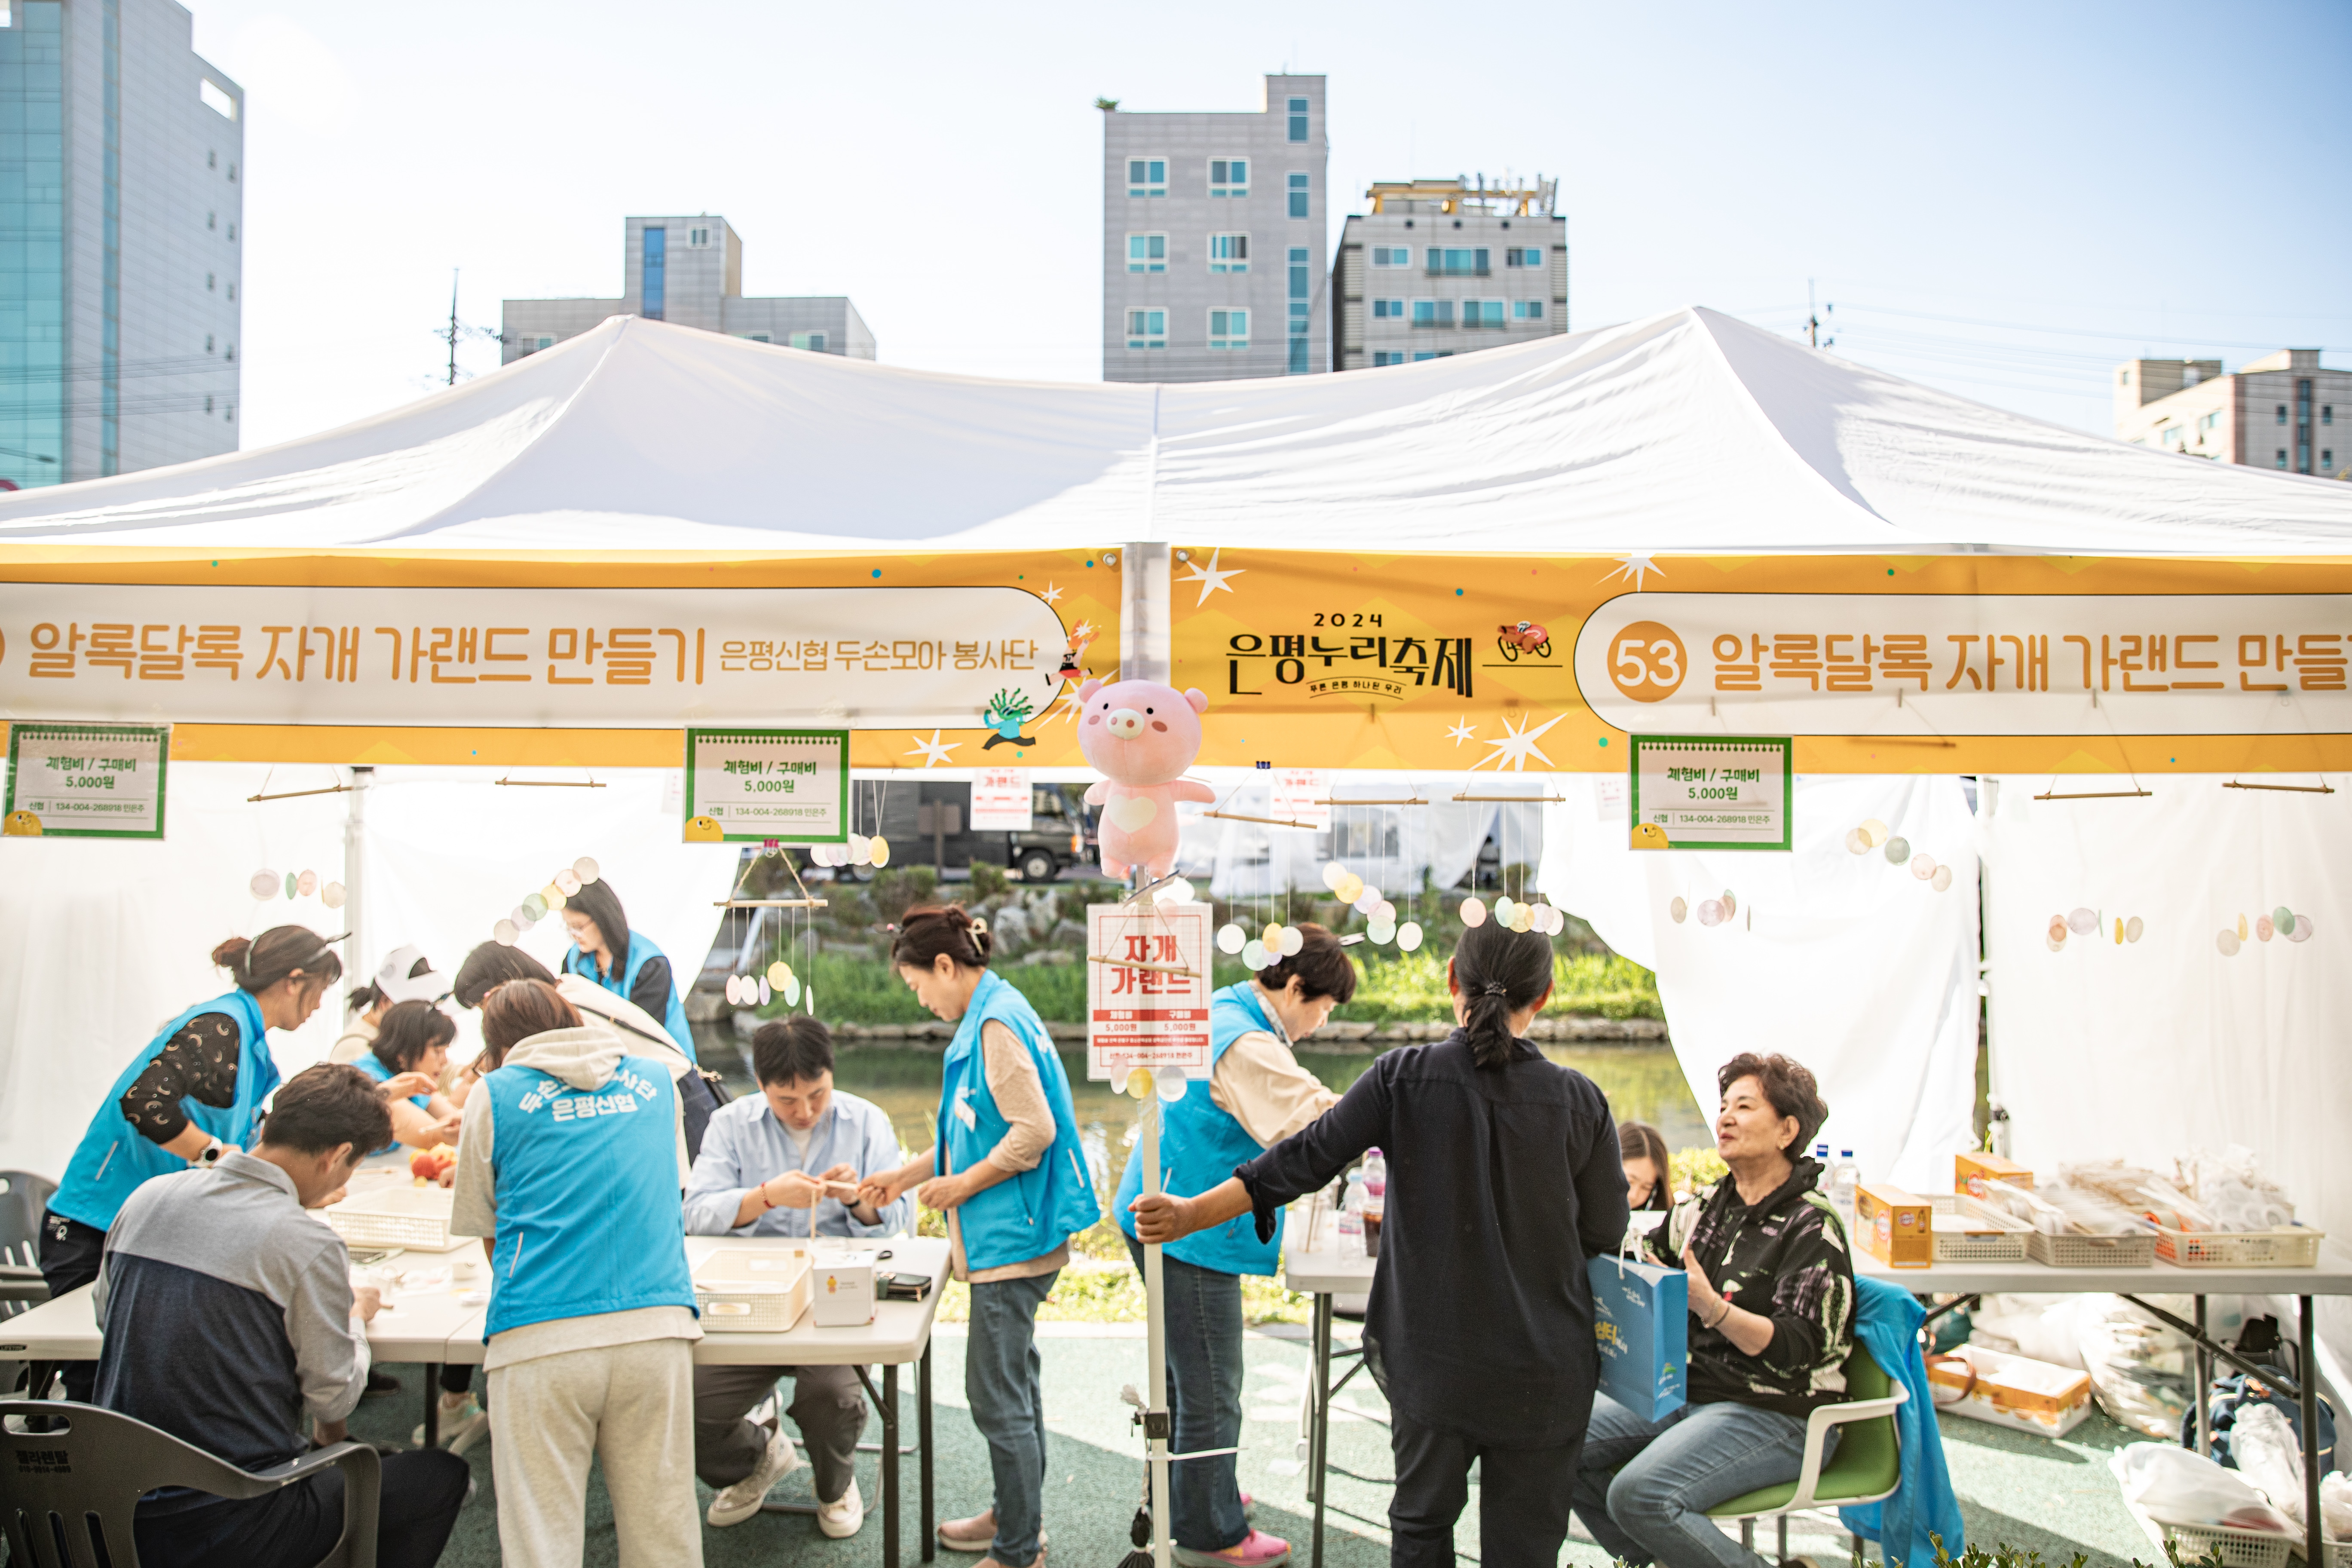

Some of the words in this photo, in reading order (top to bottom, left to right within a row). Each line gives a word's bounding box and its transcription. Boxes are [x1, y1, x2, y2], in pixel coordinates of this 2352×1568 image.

[1313, 613, 1382, 628] 2024
[29, 622, 244, 681] 알록달록
[256, 626, 360, 683] 자개
[374, 627, 532, 684] 가랜드
[547, 628, 705, 685] 만들기
[720, 640, 828, 671] 은평신협
[834, 641, 946, 671] 두손모아
[953, 640, 1038, 671] 봉사단
[1226, 634, 1473, 698] 은평누리축제
[1617, 640, 1680, 686] 53
[1712, 633, 1933, 692] 알록달록
[1946, 634, 2049, 692] 자개
[2063, 634, 2225, 692] 가랜드
[2238, 634, 2352, 692] 만들
[46, 756, 84, 771] 체험비
[98, 759, 136, 772] 구매비
[723, 759, 762, 775] 체험비
[777, 761, 817, 775] 구매비
[65, 775, 114, 789] 5,000원
[1667, 766, 1706, 782] 체험비
[1720, 769, 1760, 782] 구매비
[744, 779, 794, 793] 5,000원
[1688, 787, 1738, 800] 5,000원
[1124, 935, 1176, 962] 자개
[1111, 967, 1191, 995] 가랜드
[1106, 1023, 1137, 1032] 5,000원
[1164, 1023, 1196, 1032] 5,000원
[551, 1093, 639, 1122] 은평신협
